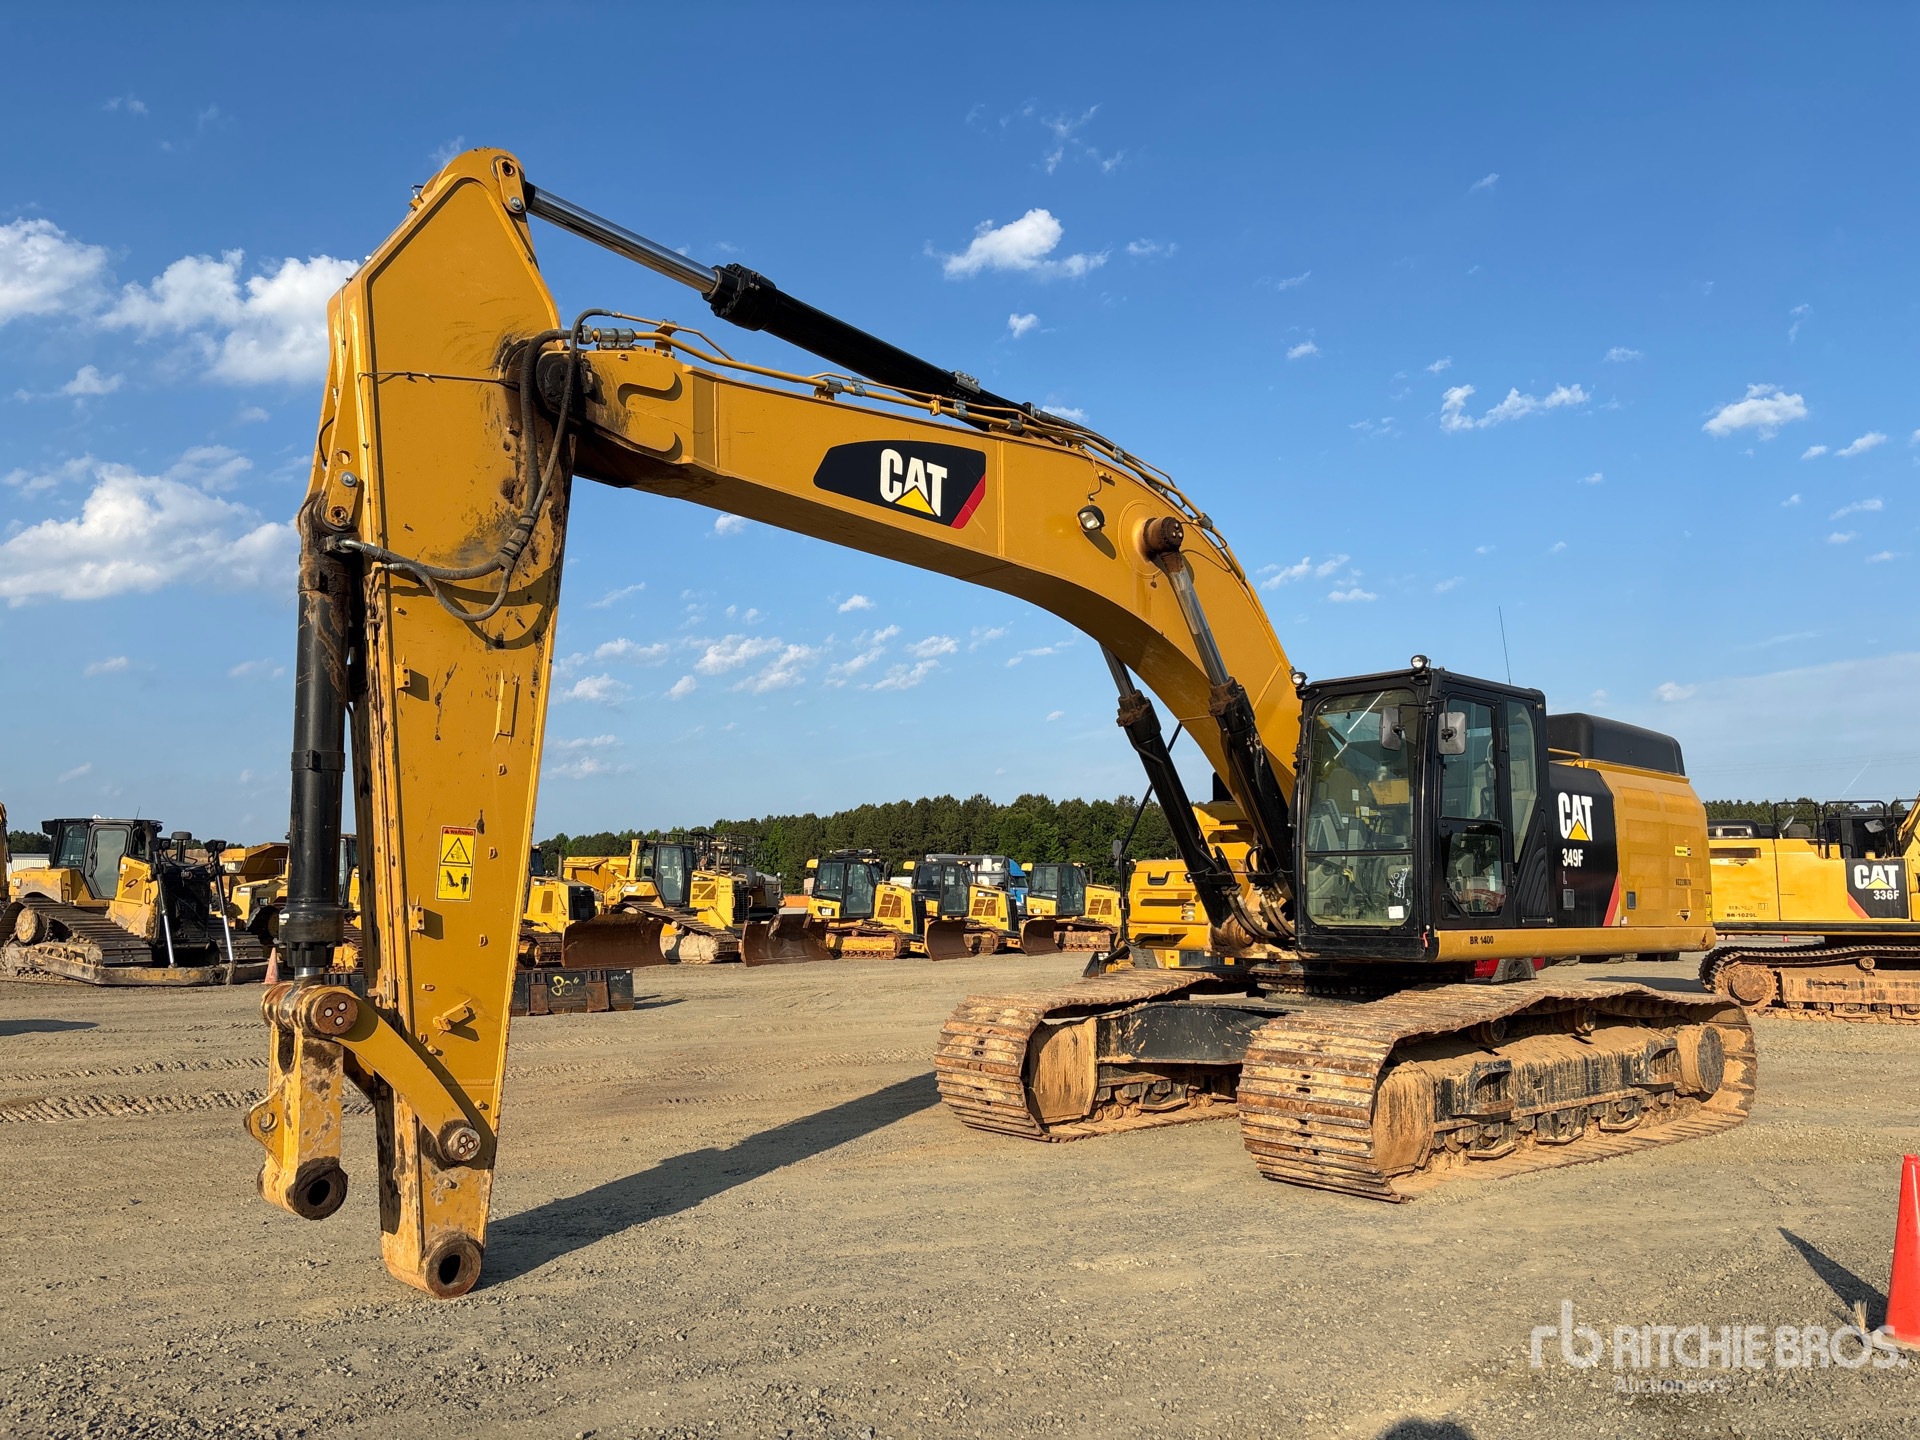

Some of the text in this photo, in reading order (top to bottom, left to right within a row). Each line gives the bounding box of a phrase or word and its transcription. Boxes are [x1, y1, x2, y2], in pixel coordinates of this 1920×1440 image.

[880, 448, 948, 517] CAT
[1557, 791, 1593, 842] CAT
[1561, 847, 1584, 868] 349F
[1853, 864, 1899, 890] CAT
[1873, 889, 1900, 900] 336F
[821, 907, 833, 916] CAT
[1469, 935, 1494, 945] BR 1400
